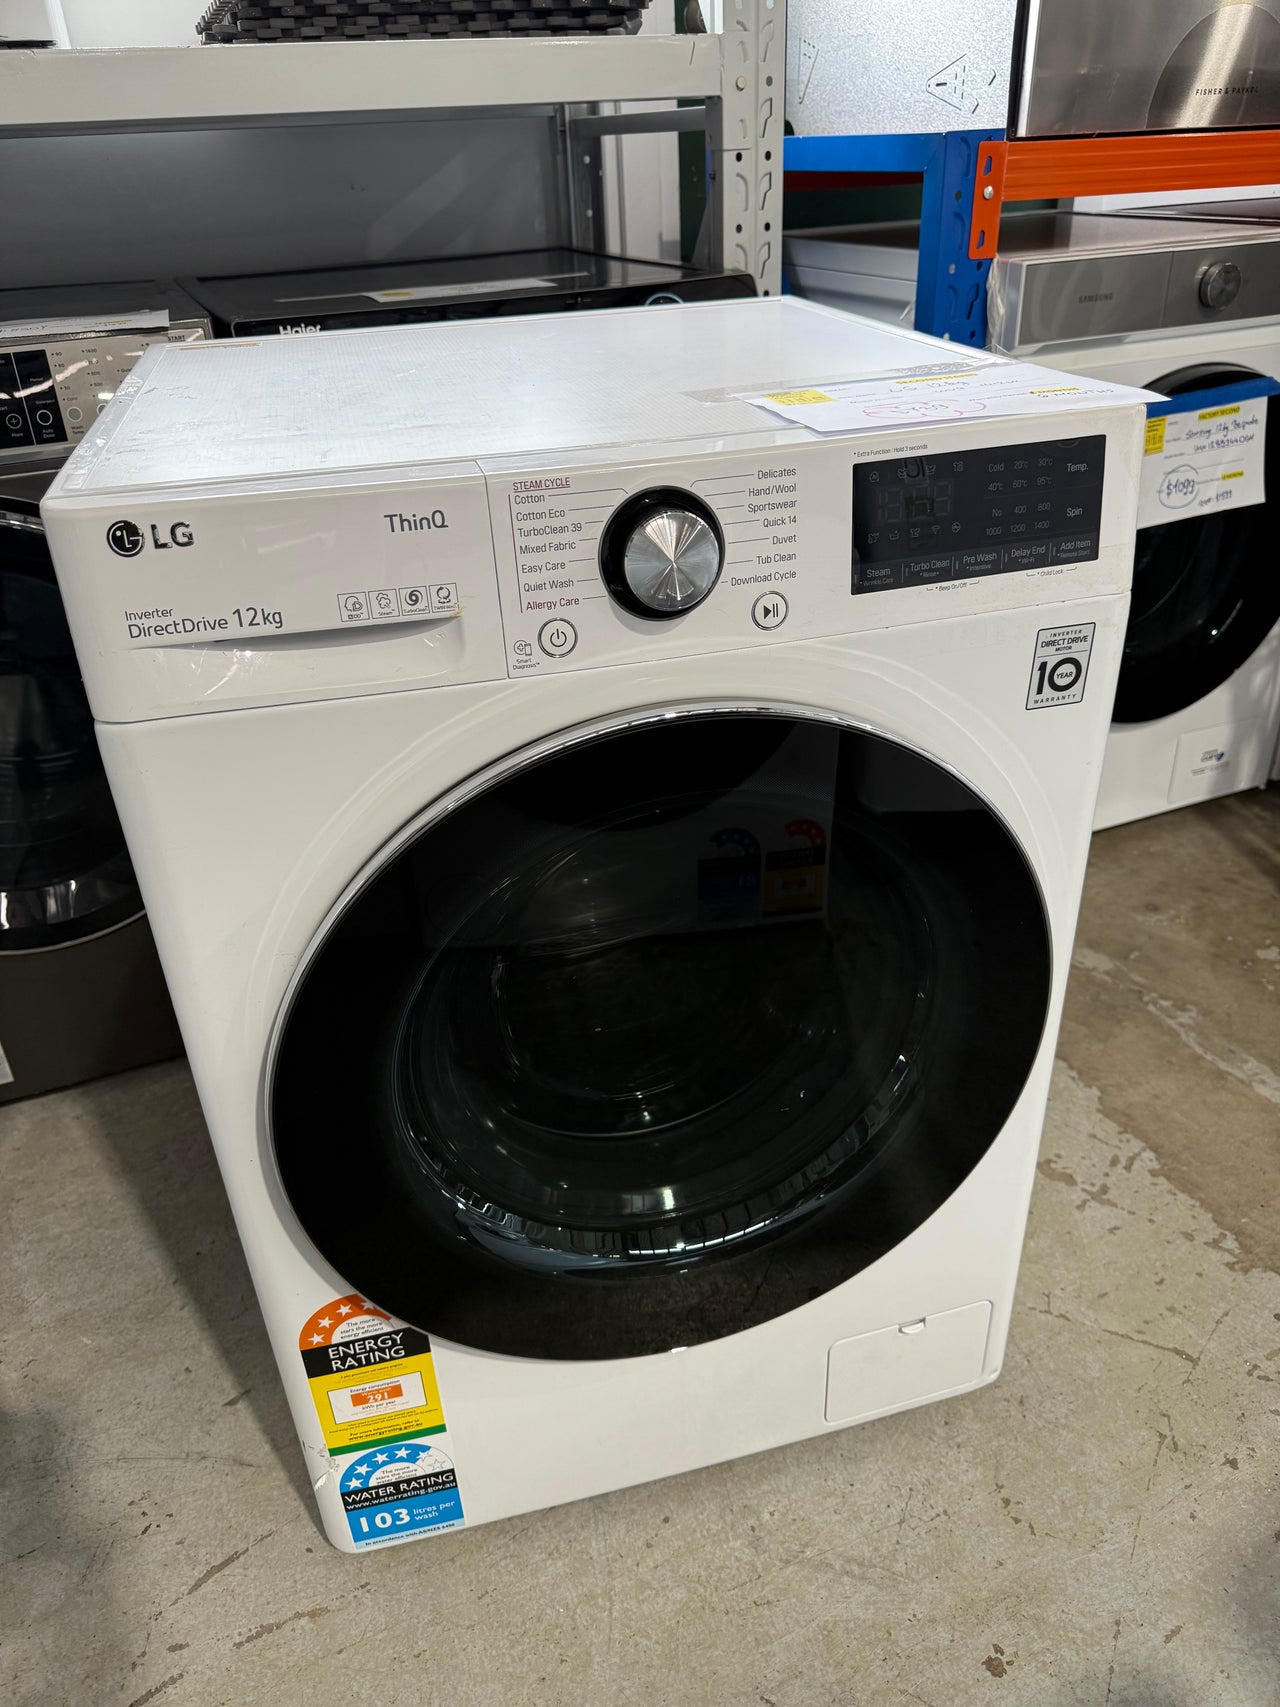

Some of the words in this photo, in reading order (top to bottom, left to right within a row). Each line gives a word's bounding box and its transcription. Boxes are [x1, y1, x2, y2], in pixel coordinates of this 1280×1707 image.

[1078, 293, 1113, 304] SAMSUNG
[857, 449, 869, 458] Extra
[870, 448, 890, 456] Function
[909, 443, 928, 451] seconds
[757, 467, 797, 480] Delicates
[989, 462, 1004, 472] Cold
[1067, 462, 1089, 473] Temp.
[513, 480, 543, 491] STEAM
[544, 477, 570, 489] CYCLE
[748, 483, 797, 496] Hand/Wool
[1166, 479, 1195, 498] $1099
[514, 494, 545, 505] Cotton
[748, 499, 797, 514] Sportswear
[992, 508, 1002, 517] No
[1014, 505, 1026, 514] 400
[1038, 502, 1050, 511] 800
[1066, 507, 1083, 517] Spin
[384, 510, 448, 533] ThinQ
[516, 510, 547, 522] Cotton
[548, 508, 565, 519] Eco
[763, 518, 786, 529] Quick
[787, 516, 797, 526] 14
[986, 526, 1001, 536] 1000
[1010, 523, 1026, 533] 1200
[1034, 520, 1050, 530] 1400
[151, 522, 194, 549] LG
[518, 523, 569, 538] TurboClean
[570, 522, 582, 533] 39
[772, 534, 797, 545] Duvet
[1060, 541, 1074, 551] Add
[1074, 539, 1090, 548] Item
[519, 543, 546, 555] Mixed
[547, 540, 576, 552] Fabric
[1011, 548, 1031, 558] Delay
[1032, 546, 1045, 555] End
[756, 555, 773, 565] Tub
[775, 552, 797, 563] Clean
[963, 555, 975, 564] Pre
[977, 552, 997, 562] Wash
[522, 562, 543, 575] Easy
[545, 560, 566, 571] Care
[910, 562, 929, 571] Turbo
[931, 559, 949, 569] Clean
[731, 573, 772, 586] Download
[774, 570, 797, 583] Cycle
[866, 567, 891, 577] Steam
[1040, 569, 1051, 577] Child
[1052, 568, 1064, 576] Lock
[523, 582, 546, 593] Quiet
[548, 579, 574, 590] Wash
[939, 584, 951, 592] Beep
[952, 582, 967, 590] On/Off
[526, 599, 557, 612] Allergy
[558, 597, 580, 607] Care
[125, 607, 173, 621] Inverter
[128, 616, 228, 639] DirectDrive
[232, 607, 283, 629] 12kg
[1041, 638, 1066, 648] DIRECT
[1067, 635, 1088, 644] DRIVE
[1036, 657, 1082, 695] 10
[1034, 694, 1076, 704] WARRANTY
[362, 1327, 384, 1335] efficient
[328, 1332, 403, 1360] ENERGY
[331, 1346, 405, 1372] RATING
[368, 1379, 401, 1389] consumption
[367, 1394, 389, 1403] 291
[349, 1422, 423, 1441] www.energyrating.gov.au
[373, 1424, 401, 1433] information,
[395, 1473, 417, 1481] efficient
[344, 1487, 396, 1502] WATER
[400, 1472, 454, 1491] RATING
[346, 1482, 456, 1510] www.waterrating.gov.au
[360, 1508, 411, 1533] 103
[413, 1505, 437, 1514] litres
[439, 1500, 455, 1510] per
[415, 1511, 438, 1520] wash
[372, 1535, 404, 1545] accordance
